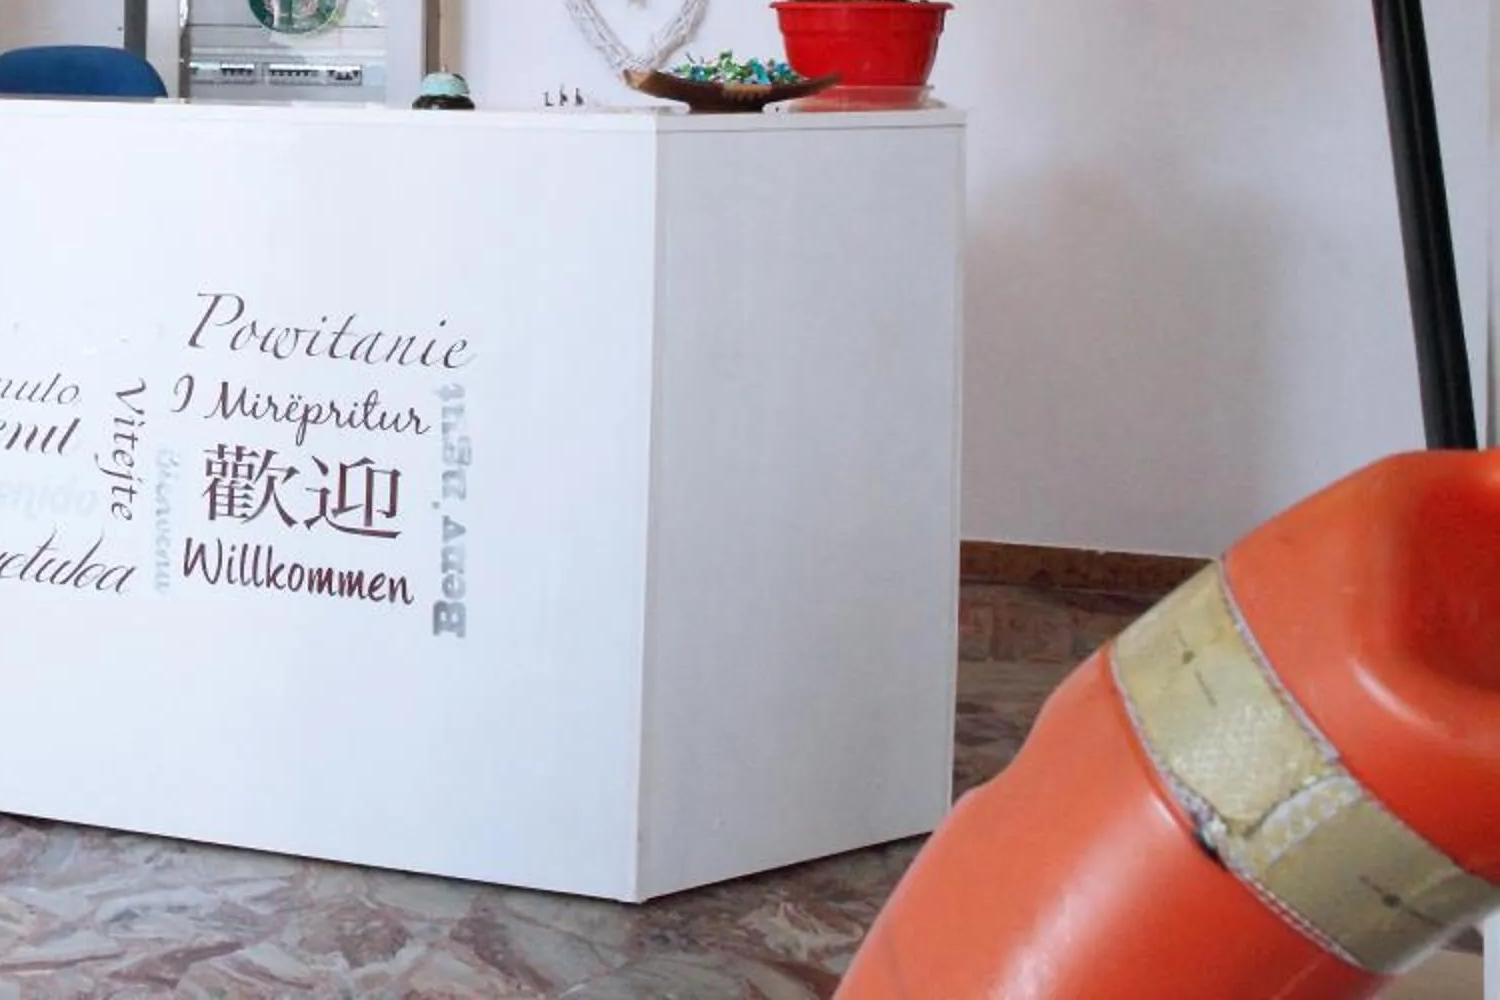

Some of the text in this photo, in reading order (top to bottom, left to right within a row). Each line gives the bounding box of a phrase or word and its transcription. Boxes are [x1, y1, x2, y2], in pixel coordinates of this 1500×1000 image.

[188, 292, 474, 369] Powitanie
[95, 376, 147, 521] Vitejte
[204, 379, 432, 447] Mirëpritur
[202, 442, 402, 539] 歡迎
[431, 383, 473, 639] Benvngut
[184, 537, 415, 605] Willkommen
